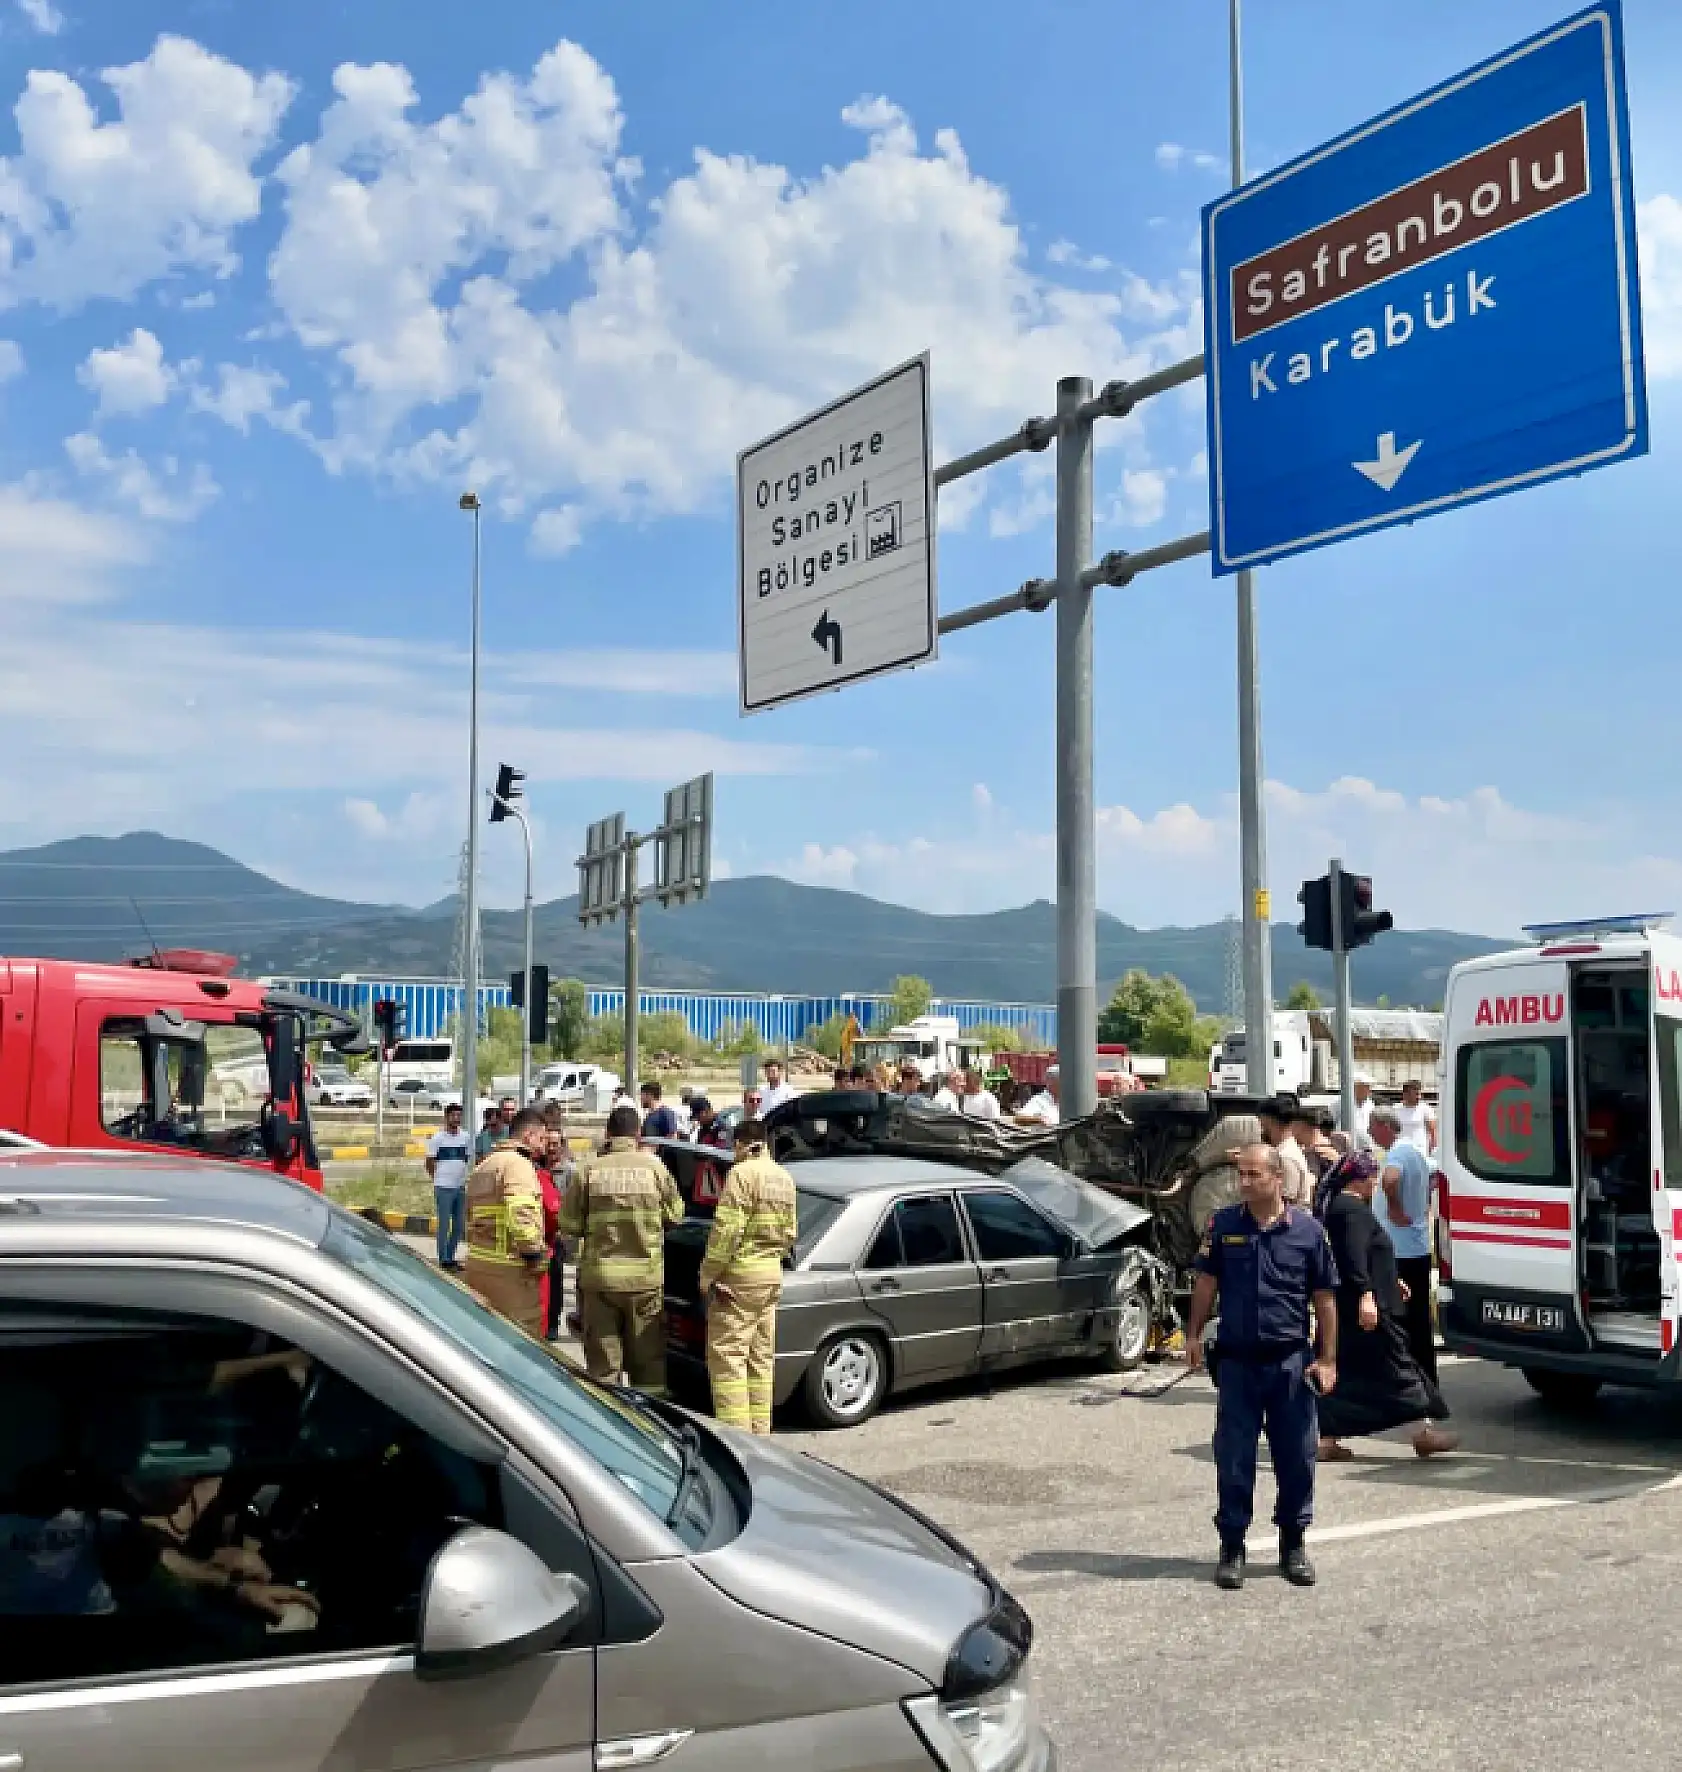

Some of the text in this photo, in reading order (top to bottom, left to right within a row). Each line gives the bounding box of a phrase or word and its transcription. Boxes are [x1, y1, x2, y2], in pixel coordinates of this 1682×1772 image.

[1247, 150, 1565, 316] Safranbolu
[1250, 269, 1497, 400] Karabük
[756, 430, 883, 510] Organize
[771, 479, 869, 547] Sanayi
[756, 532, 858, 599] Bölgesi
[1474, 992, 1565, 1027] AMBU
[1496, 1101, 1533, 1137] 112
